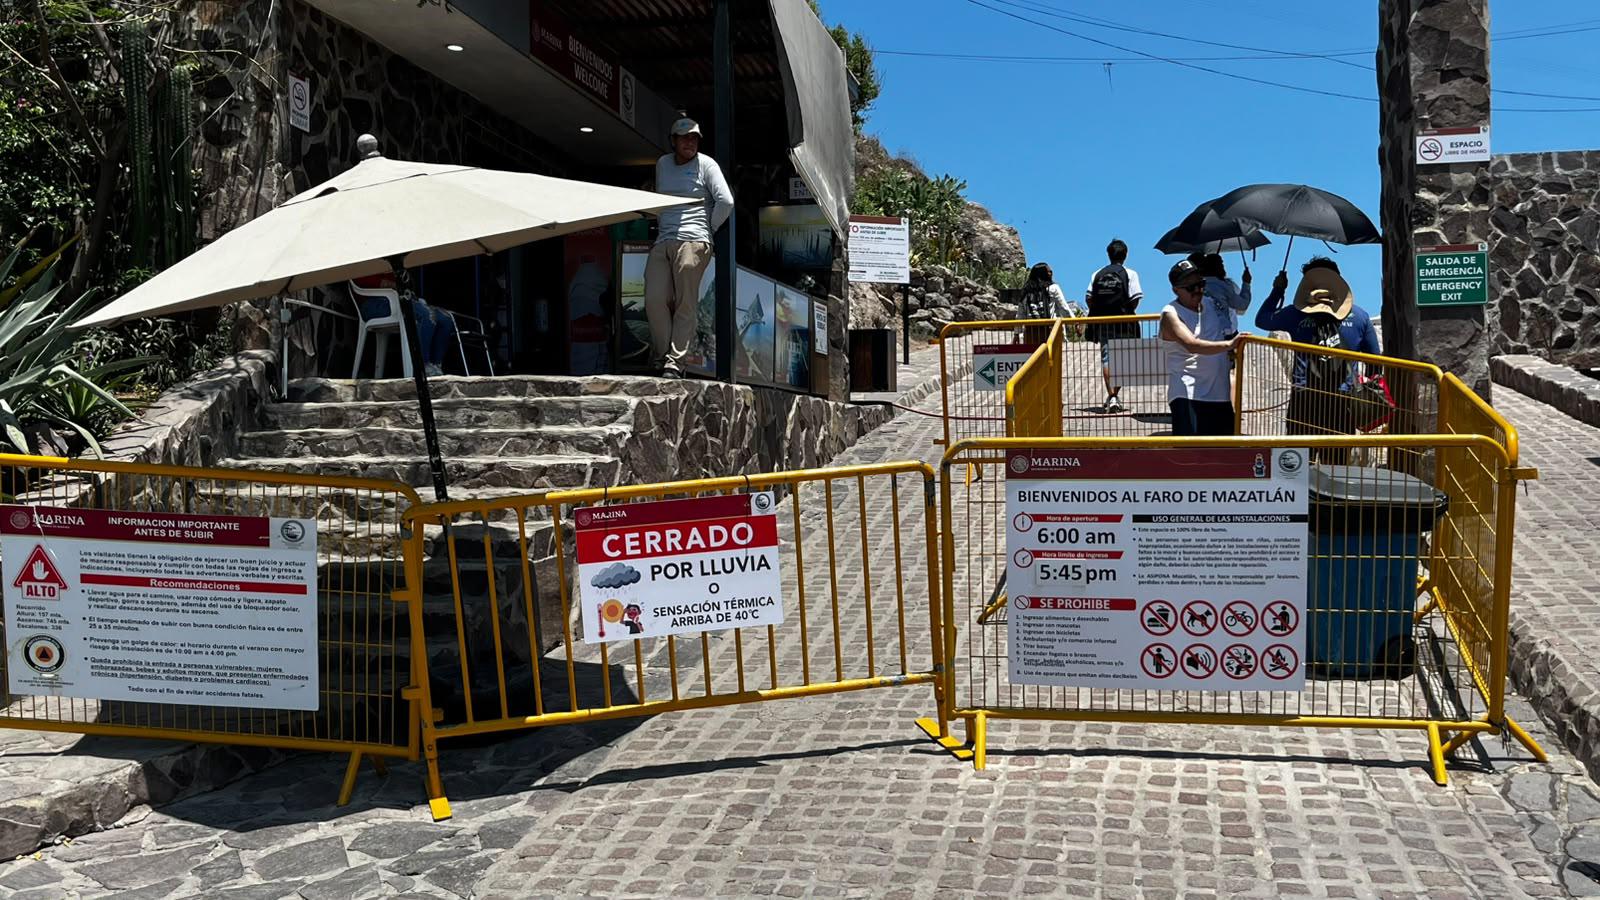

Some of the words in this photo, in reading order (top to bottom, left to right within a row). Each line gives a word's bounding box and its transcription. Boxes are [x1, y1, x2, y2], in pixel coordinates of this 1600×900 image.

[568, 34, 612, 80] BIENVENIDOS
[574, 62, 608, 99] WELCOME
[1426, 257, 1460, 265] SALIDA
[1420, 266, 1483, 276] EMERGENCIA
[1422, 281, 1482, 290] EMERGENCY
[1031, 457, 1080, 467] MARINA
[1018, 490, 1117, 503] BIENVENIDOS
[1122, 490, 1139, 503] AL
[1144, 490, 1183, 503] FARO
[1188, 491, 1207, 503] DE
[1212, 488, 1296, 502] MAZATLÁN
[32, 511, 84, 525] MARINA
[593, 511, 627, 519] MARINA
[109, 517, 175, 528] INFORMACION
[178, 520, 239, 530] IMPORTANTE
[135, 528, 166, 537] ANTES
[184, 530, 214, 539] SUBIR
[602, 522, 753, 557] CERRADO
[1037, 528, 1079, 544] 6:00
[1086, 532, 1115, 544] am
[157, 555, 193, 563] obligación
[651, 562, 693, 581] POR
[700, 554, 770, 576] LLUVIA
[1040, 564, 1082, 580] 5:45
[1086, 568, 1116, 584] pm
[150, 578, 240, 590] Recomendaciones
[709, 583, 719, 594] O
[26, 585, 56, 598] ALTO
[653, 600, 720, 617] SENSACIÓN
[724, 596, 774, 610] TÉRMICA
[1040, 599, 1054, 609] SE
[1057, 599, 1110, 609] PROHIBE
[671, 616, 712, 628] ARRIBA
[717, 613, 731, 623] DE
[735, 609, 759, 620] 40°C
